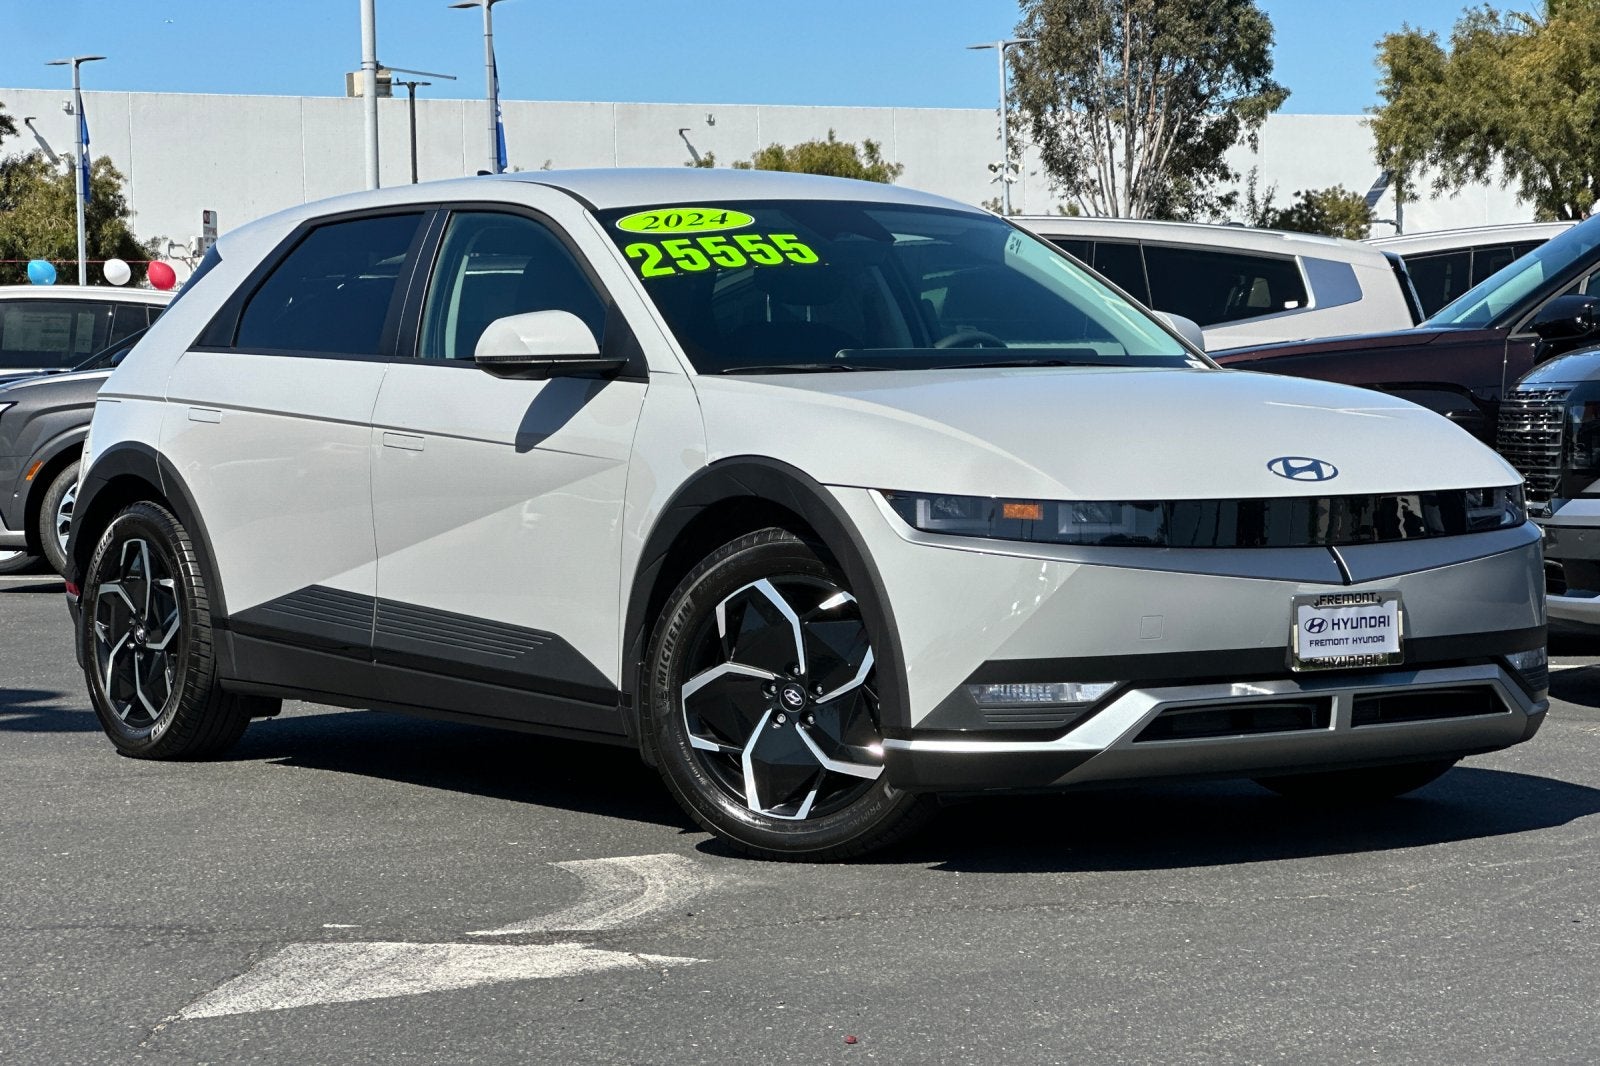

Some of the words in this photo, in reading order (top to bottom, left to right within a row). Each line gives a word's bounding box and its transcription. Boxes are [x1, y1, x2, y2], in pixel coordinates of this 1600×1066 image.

[641, 212, 729, 230] 2024
[624, 234, 819, 277] 25555
[1319, 592, 1377, 606] FREMONT
[1331, 615, 1390, 631] HYUNDAI
[656, 601, 692, 687] MICHELIN
[1309, 637, 1350, 647] FREMONT
[1352, 635, 1385, 645] HYUNDAI
[1323, 655, 1377, 667] HYUNDAI
